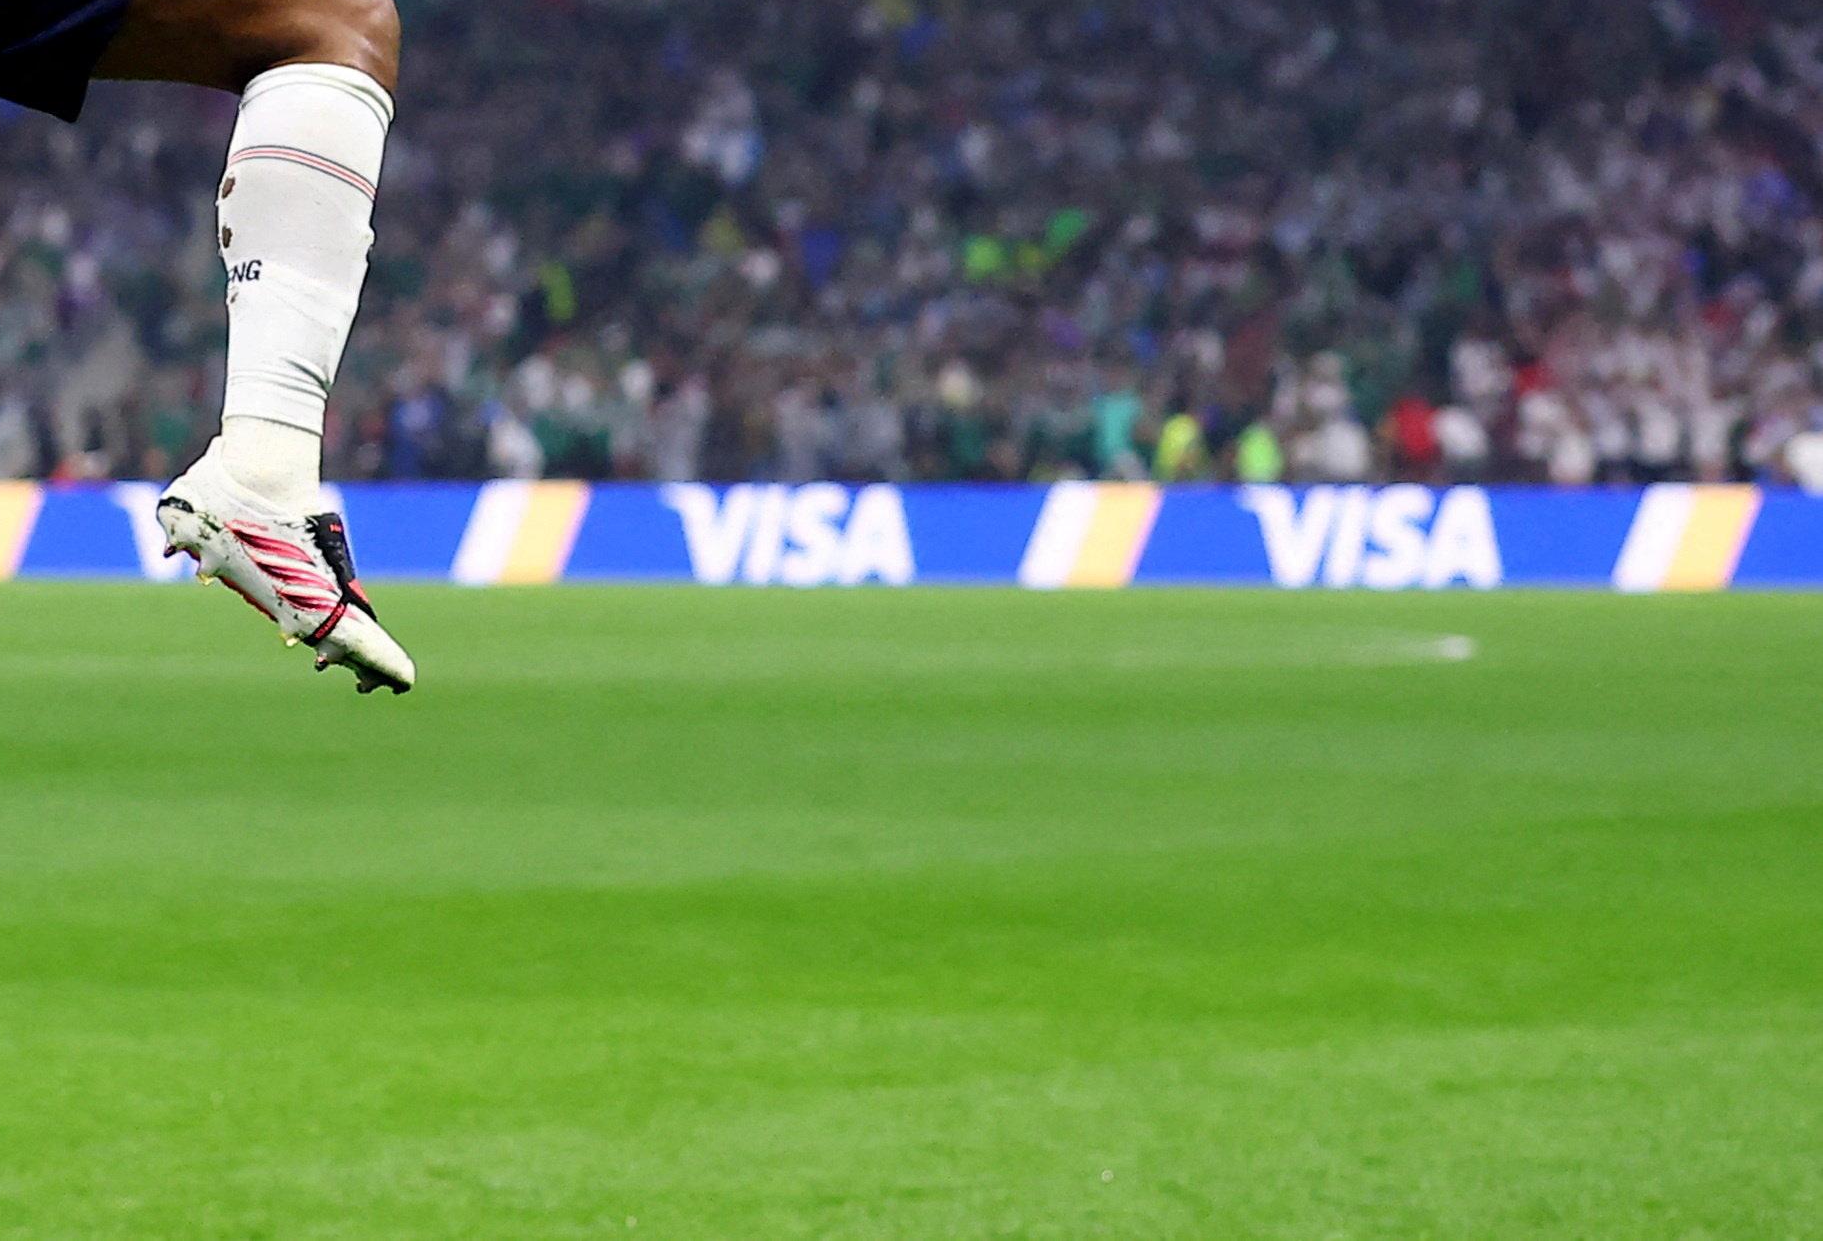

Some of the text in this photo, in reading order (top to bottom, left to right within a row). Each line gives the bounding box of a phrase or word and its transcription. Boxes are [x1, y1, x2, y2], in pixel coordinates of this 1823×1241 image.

[226, 259, 262, 283] NG
[660, 481, 916, 587] VISA
[1238, 482, 1504, 590] VISA
